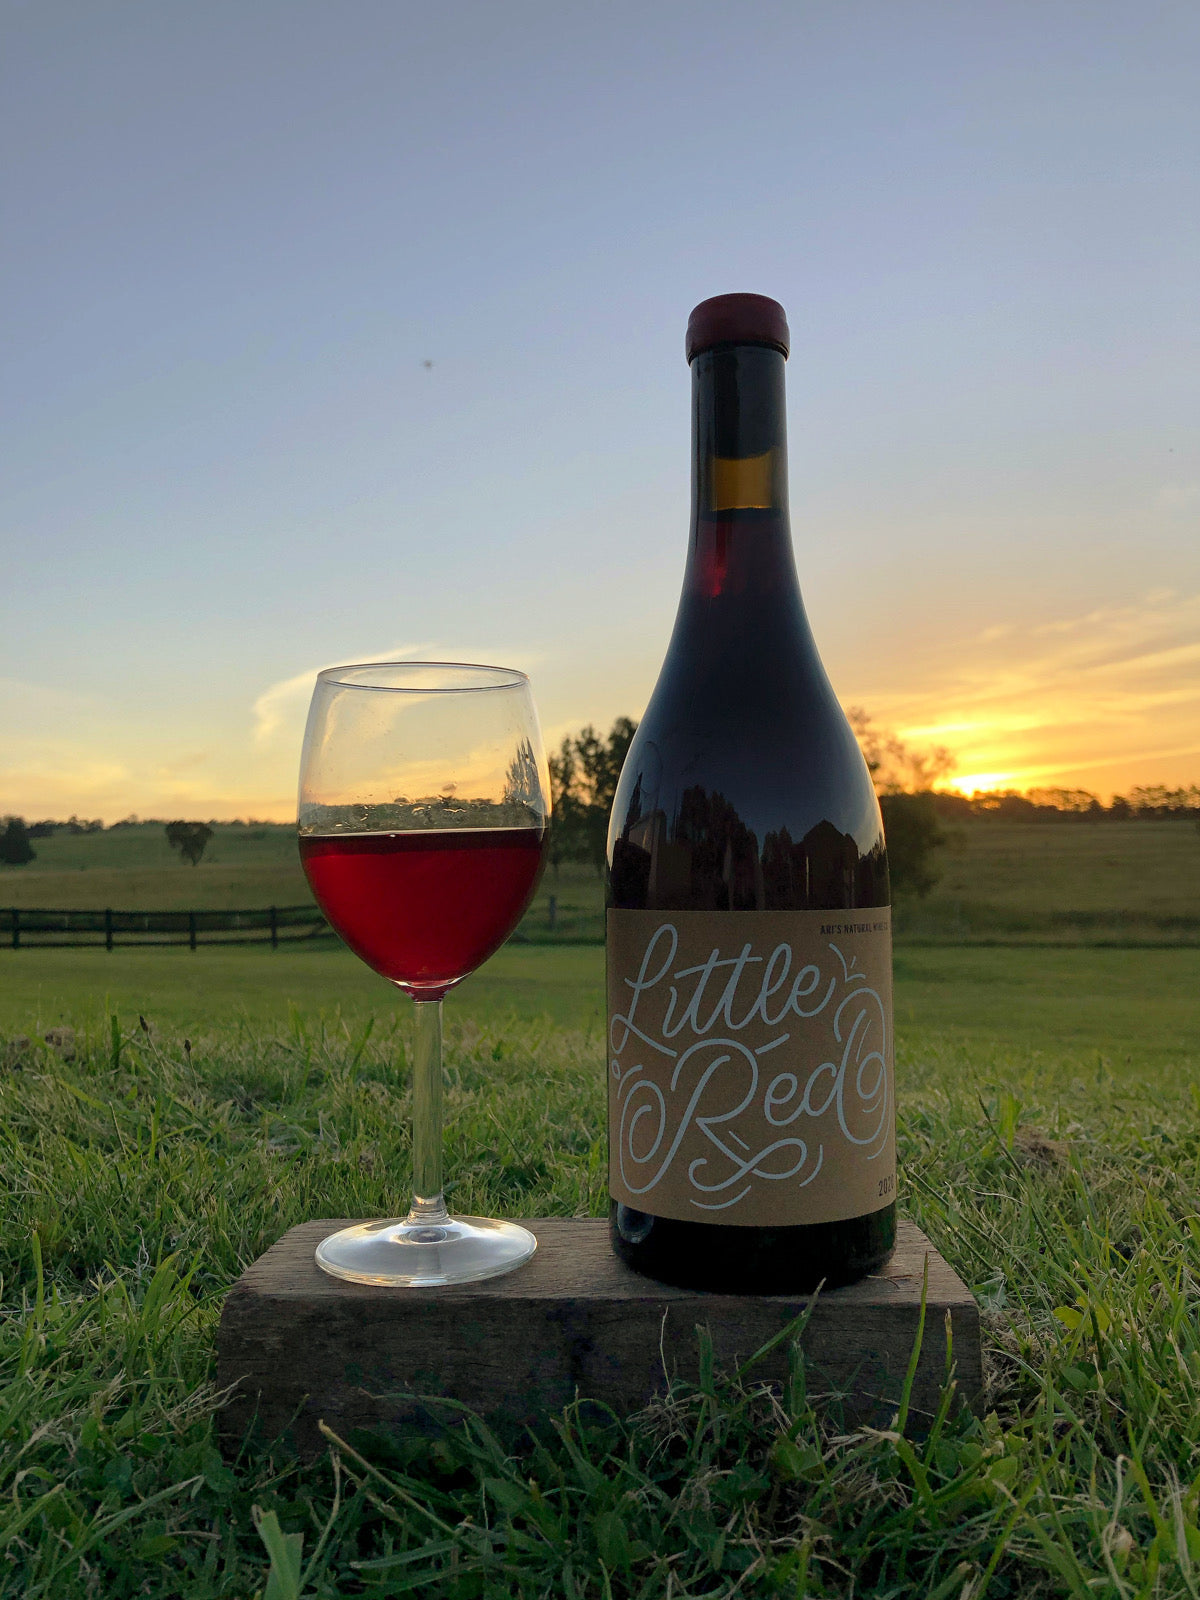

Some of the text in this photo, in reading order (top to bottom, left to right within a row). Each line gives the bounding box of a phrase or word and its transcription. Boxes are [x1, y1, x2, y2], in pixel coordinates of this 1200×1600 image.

[611, 923, 836, 1058] Little
[820, 924, 842, 935] ARI'S
[844, 923, 872, 934] NATURAL
[619, 987, 887, 1195] Red
